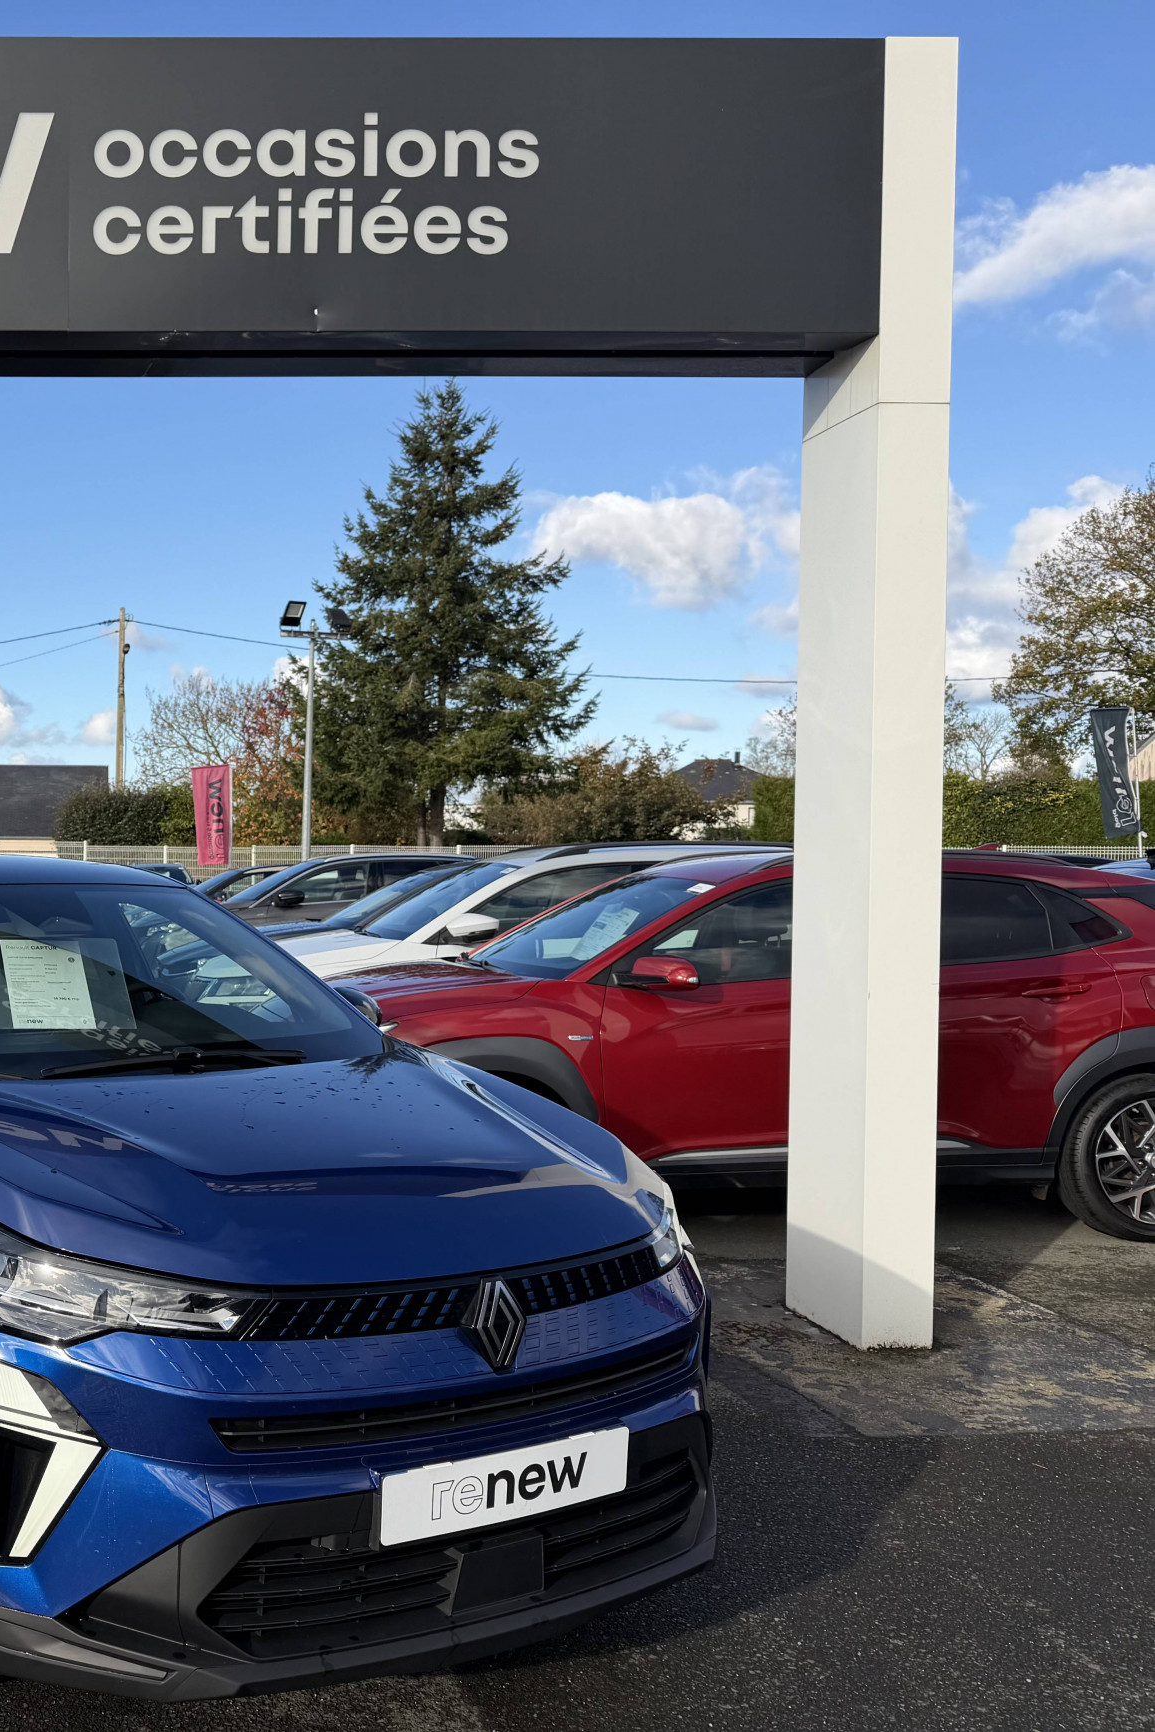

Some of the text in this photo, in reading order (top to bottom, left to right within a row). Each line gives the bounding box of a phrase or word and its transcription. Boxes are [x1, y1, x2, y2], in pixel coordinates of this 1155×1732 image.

[93, 112, 540, 178] occasions
[92, 188, 509, 255] certifiées
[431, 1451, 588, 1521] renew
